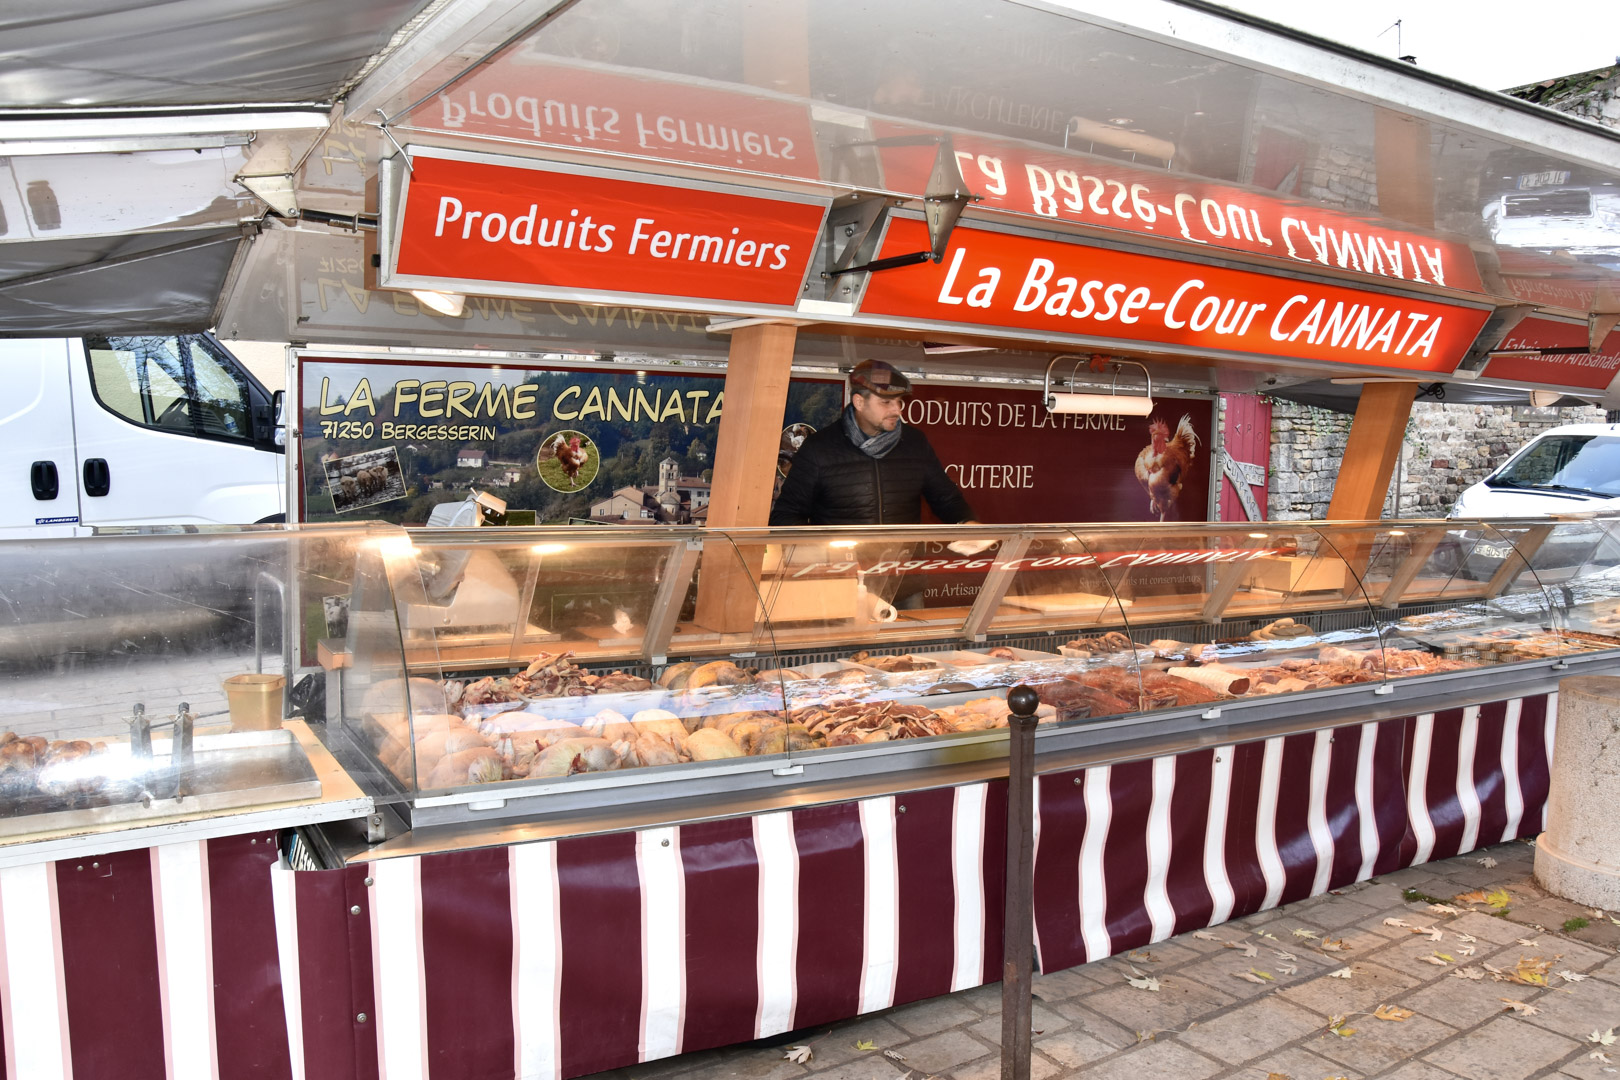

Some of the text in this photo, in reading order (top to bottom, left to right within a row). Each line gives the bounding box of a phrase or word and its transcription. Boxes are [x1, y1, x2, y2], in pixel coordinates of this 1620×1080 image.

[434, 195, 791, 271] Produits Fermiers
[937, 247, 1444, 358] La Basse-Cour CANNATA
[319, 376, 725, 424] LA FERME CANNATA
[900, 399, 992, 427] RODUITS
[997, 403, 1027, 428] DE
[1031, 405, 1057, 429] LA
[320, 420, 497, 441] 71250 BERGESSERIN
[944, 463, 1034, 489] UTERIE
[941, 583, 981, 598] Artisan
